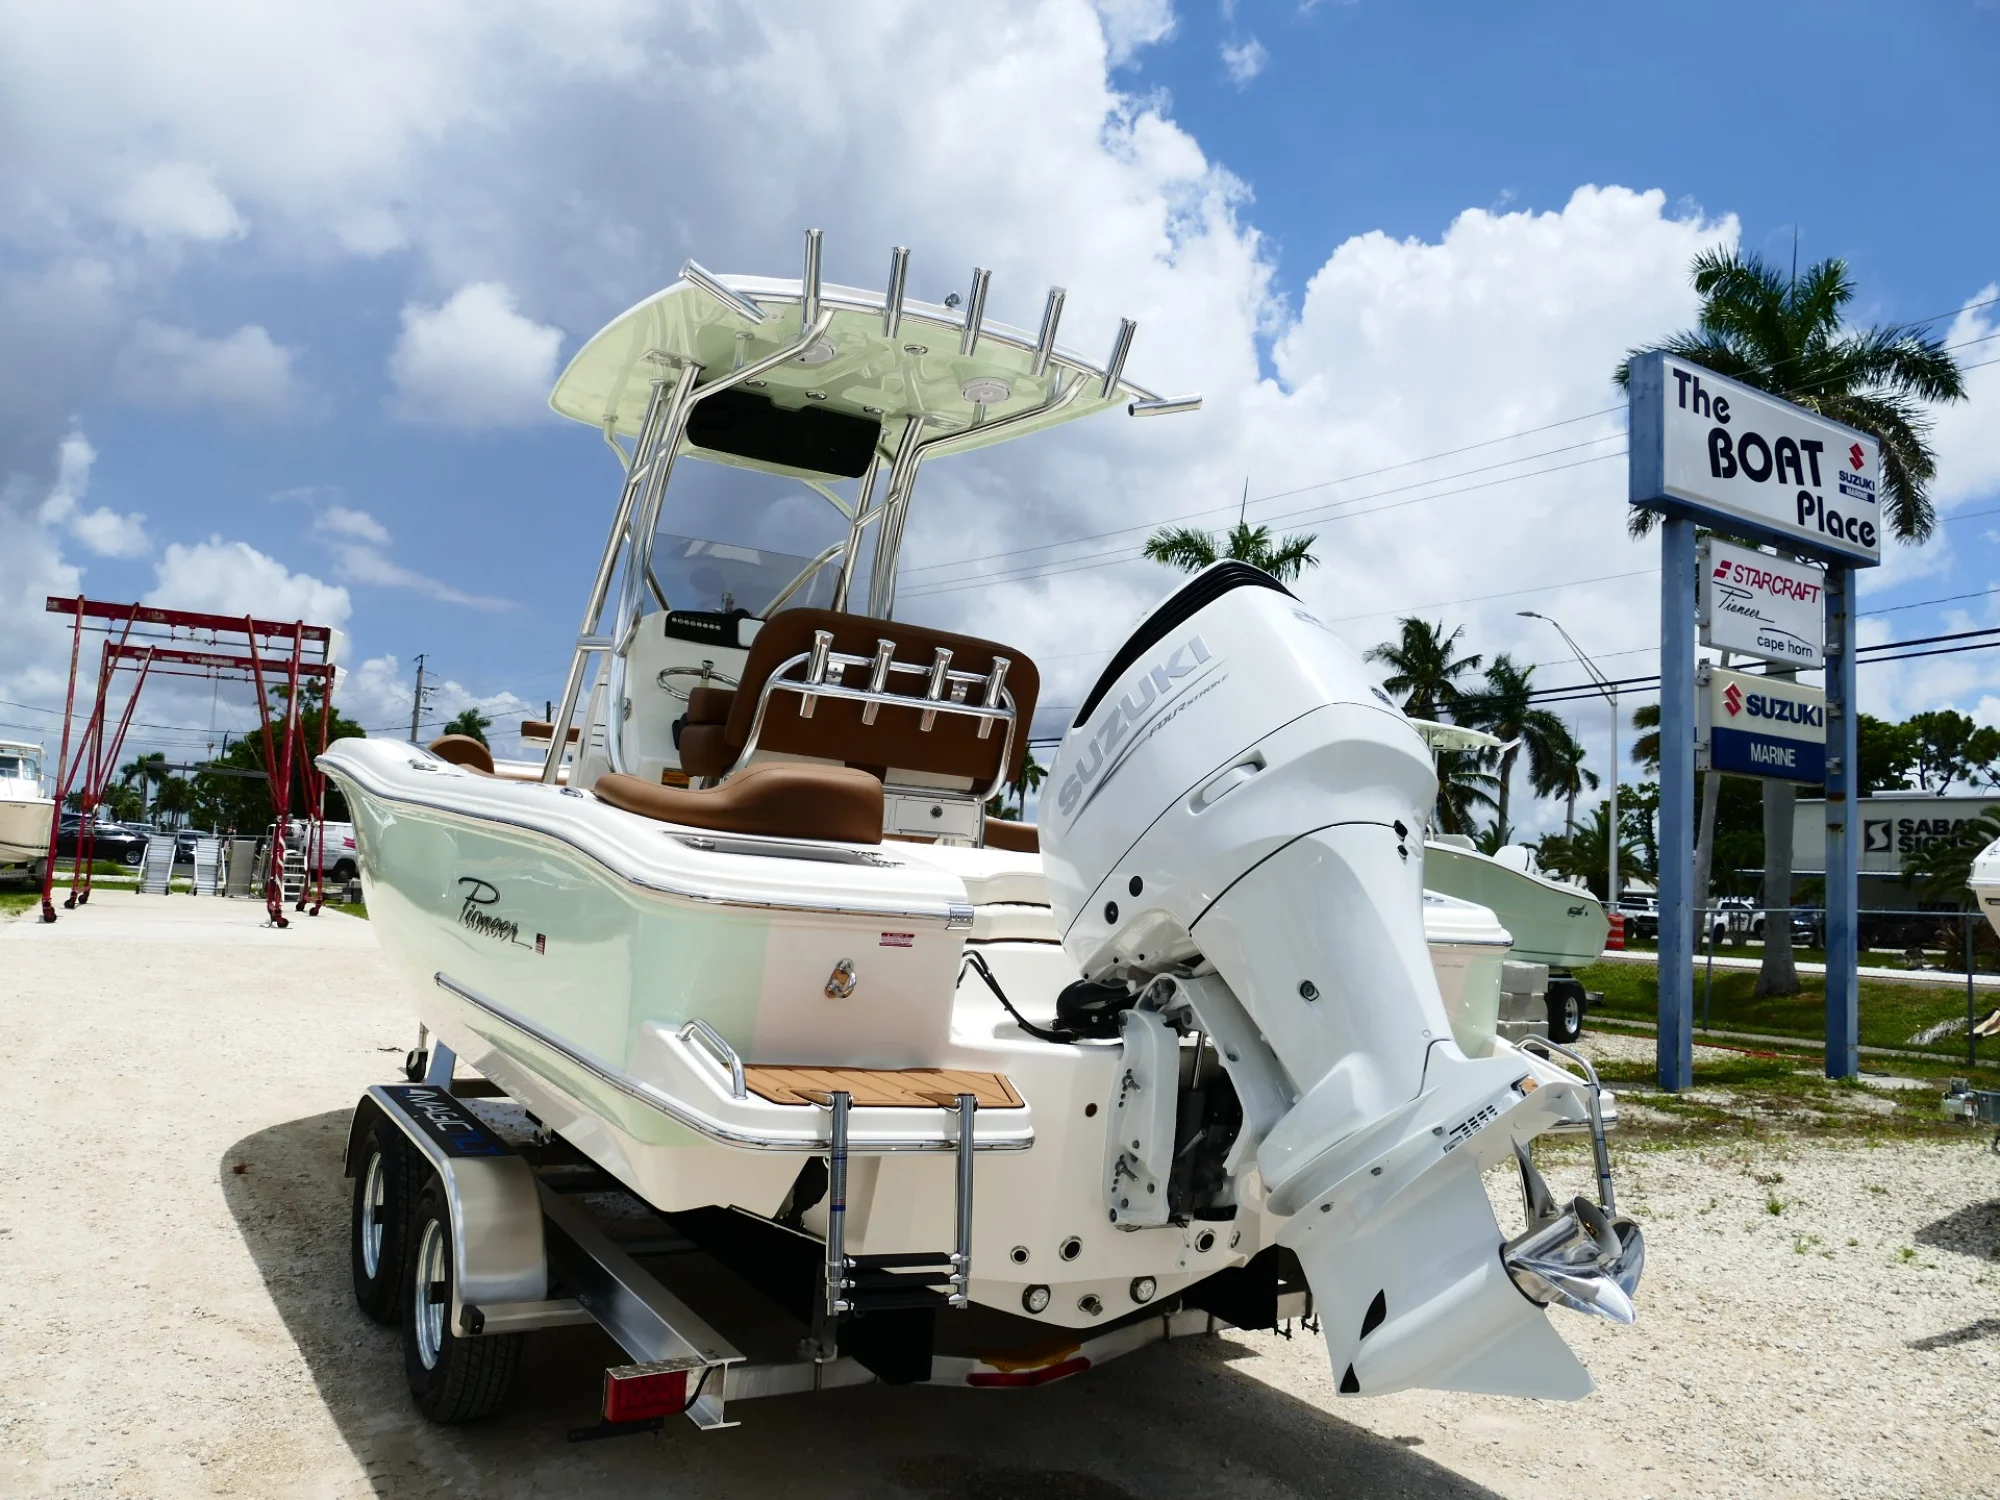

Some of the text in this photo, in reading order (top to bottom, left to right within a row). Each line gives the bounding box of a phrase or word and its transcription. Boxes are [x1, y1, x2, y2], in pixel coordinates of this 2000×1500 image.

[1672, 367, 1731, 425] The
[1708, 427, 1824, 488] BOAT
[1839, 470, 1875, 491] SUZUKI
[1797, 490, 1877, 548] Place
[1712, 580, 1775, 623] Pioneer
[1733, 564, 1822, 604] STARCRAFT
[1757, 635, 1812, 657] cape horn
[1057, 634, 1213, 818] SUZUKI
[1746, 693, 1823, 728] SUZUKI
[1750, 742, 1796, 768] MARINE
[457, 876, 533, 950] Pioneer
